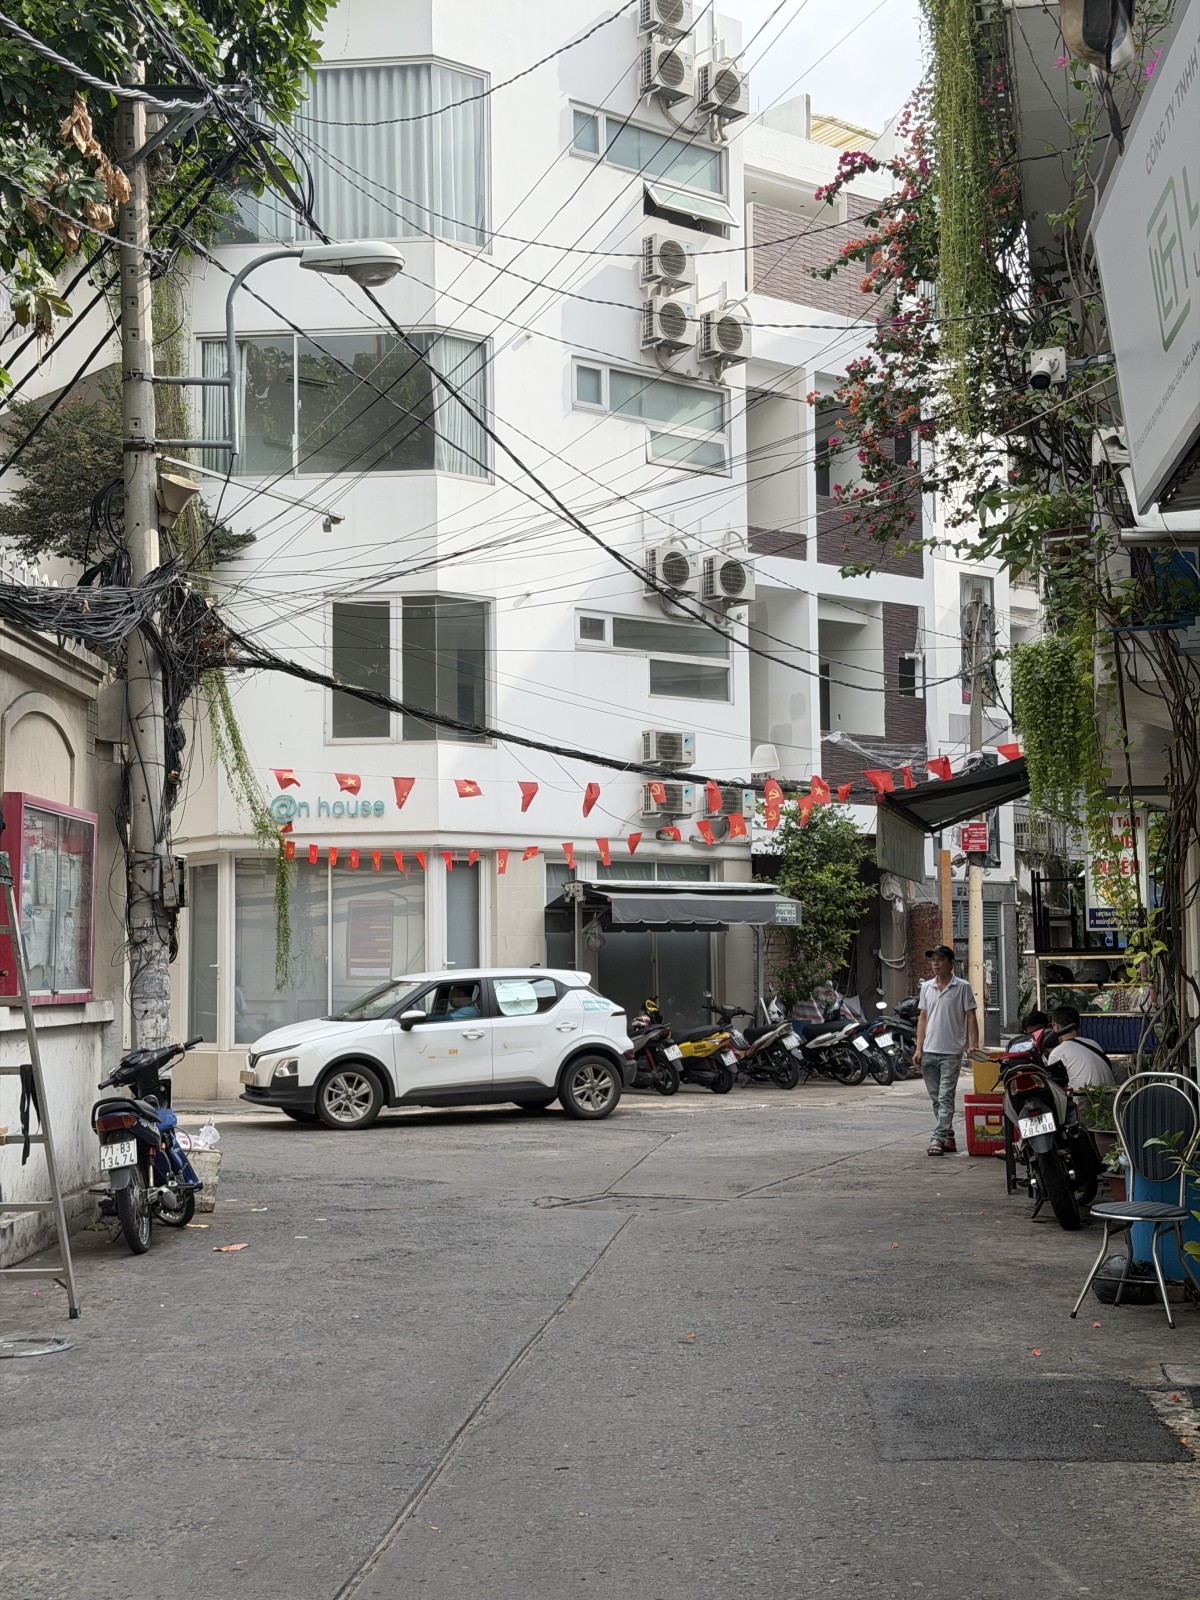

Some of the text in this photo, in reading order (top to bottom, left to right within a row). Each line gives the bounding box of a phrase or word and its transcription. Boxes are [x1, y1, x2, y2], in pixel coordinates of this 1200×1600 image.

[1145, 47, 1199, 175] CÔNG TY TNHH
[270, 794, 385, 824] @n house
[101, 1152, 135, 1169] 134.74
